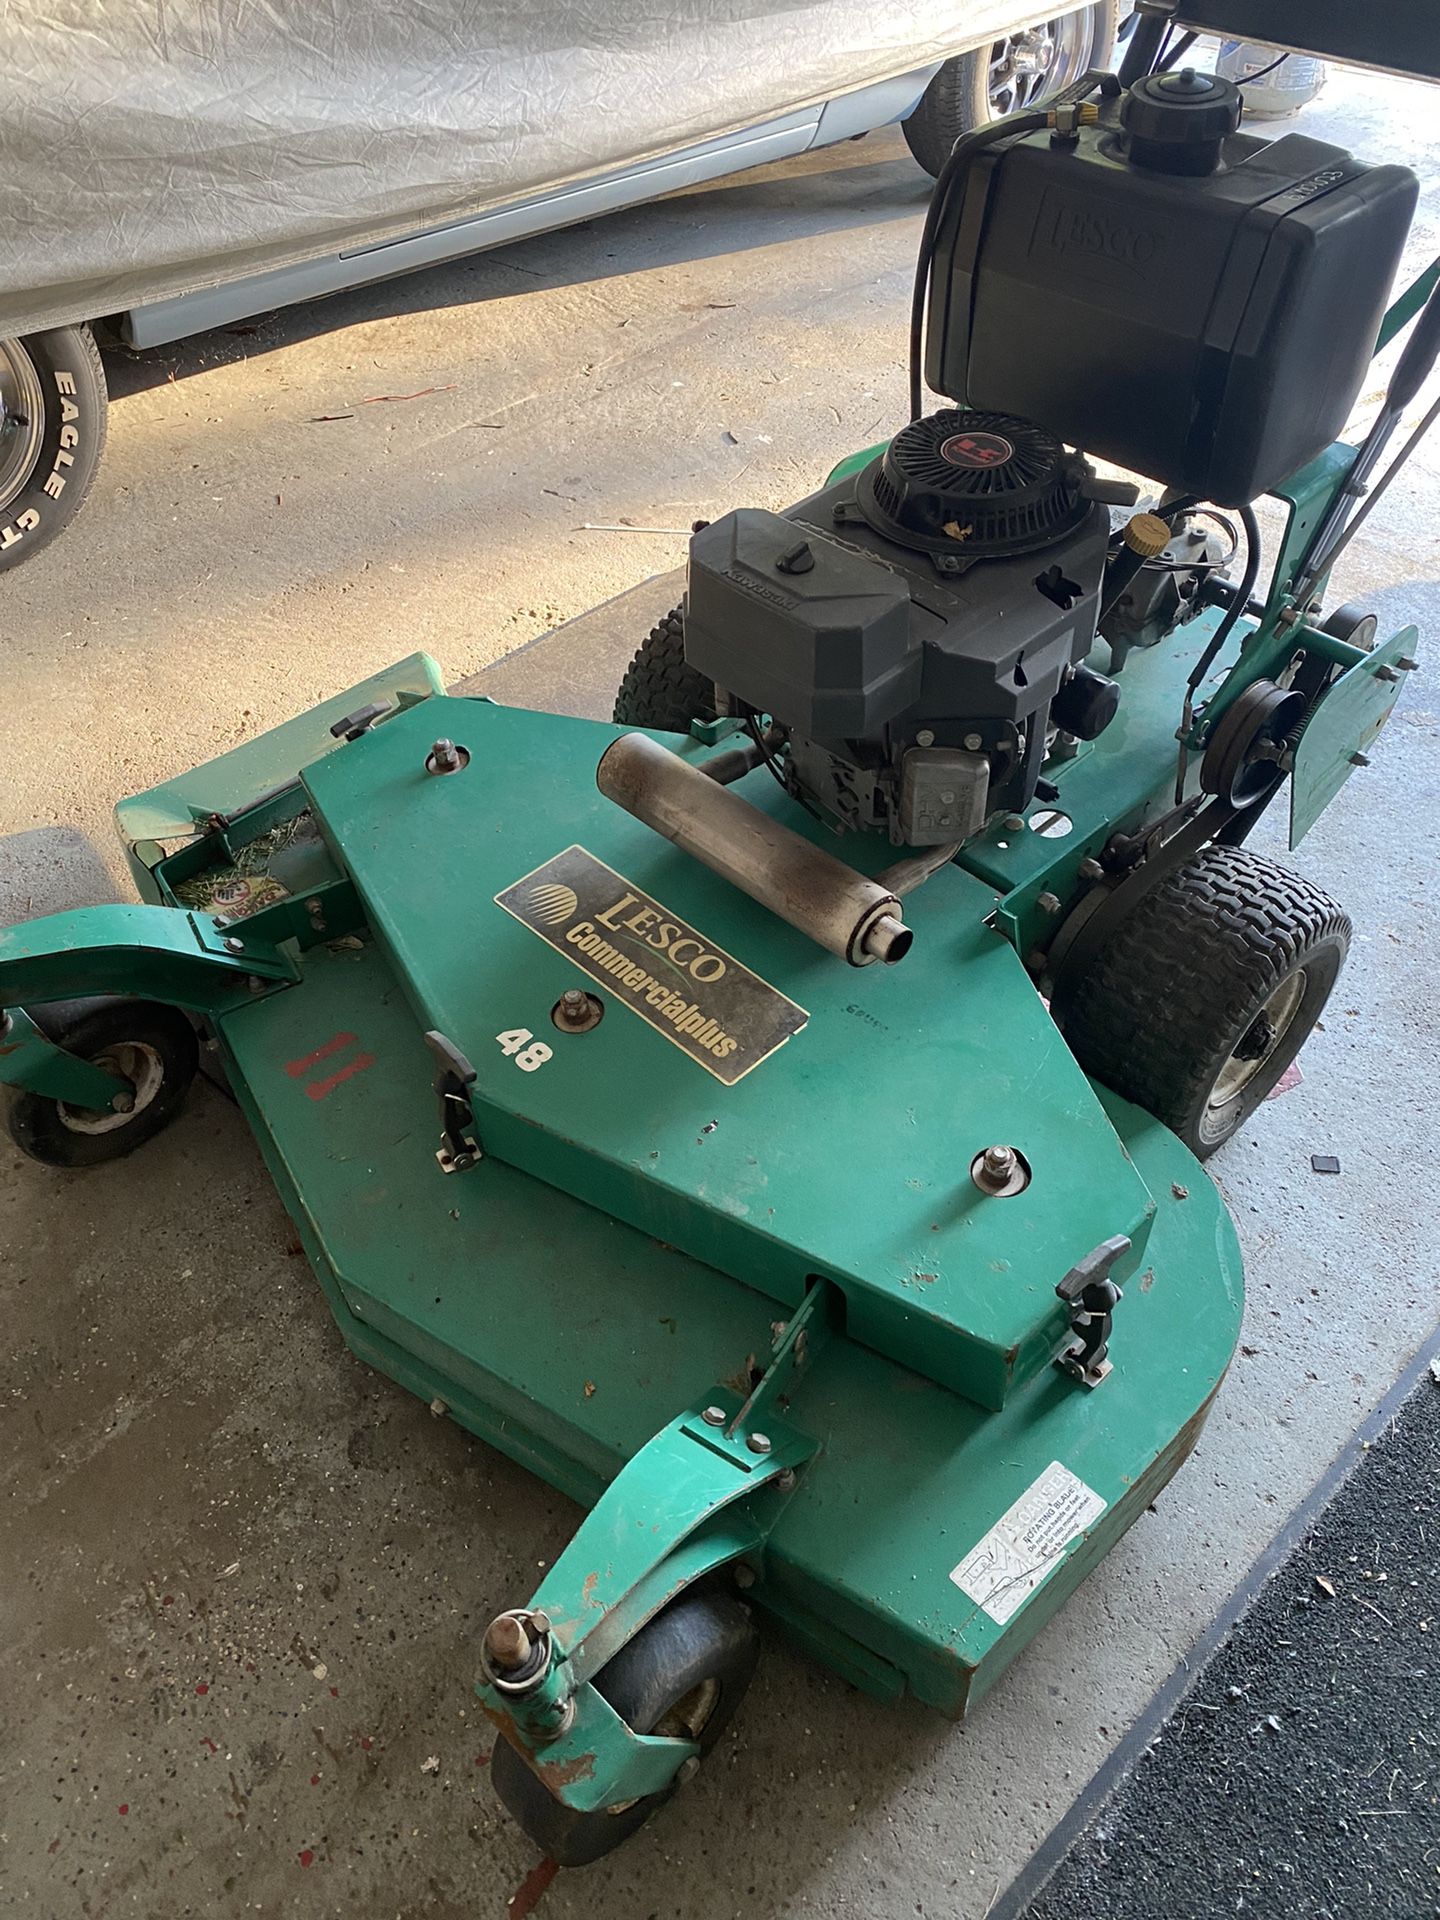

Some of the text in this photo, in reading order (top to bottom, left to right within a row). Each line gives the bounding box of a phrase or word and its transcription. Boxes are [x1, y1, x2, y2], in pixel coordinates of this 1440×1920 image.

[0, 371, 79, 549] EAGLE GT
[594, 892, 727, 982] LESCO
[565, 921, 738, 1058] Commercialplus
[495, 1028, 553, 1072] 48
[1022, 1508, 1056, 1544] ROTATING
[1028, 1544, 1037, 1553] Do
[1036, 1535, 1045, 1544] not
[1043, 1525, 1053, 1537] put
[1051, 1511, 1066, 1527] hands
[1069, 1494, 1080, 1506] feet
[1047, 1536, 1055, 1544] or
[1052, 1526, 1064, 1537] into
[1062, 1510, 1079, 1526] mower
[1079, 1496, 1092, 1511] when
